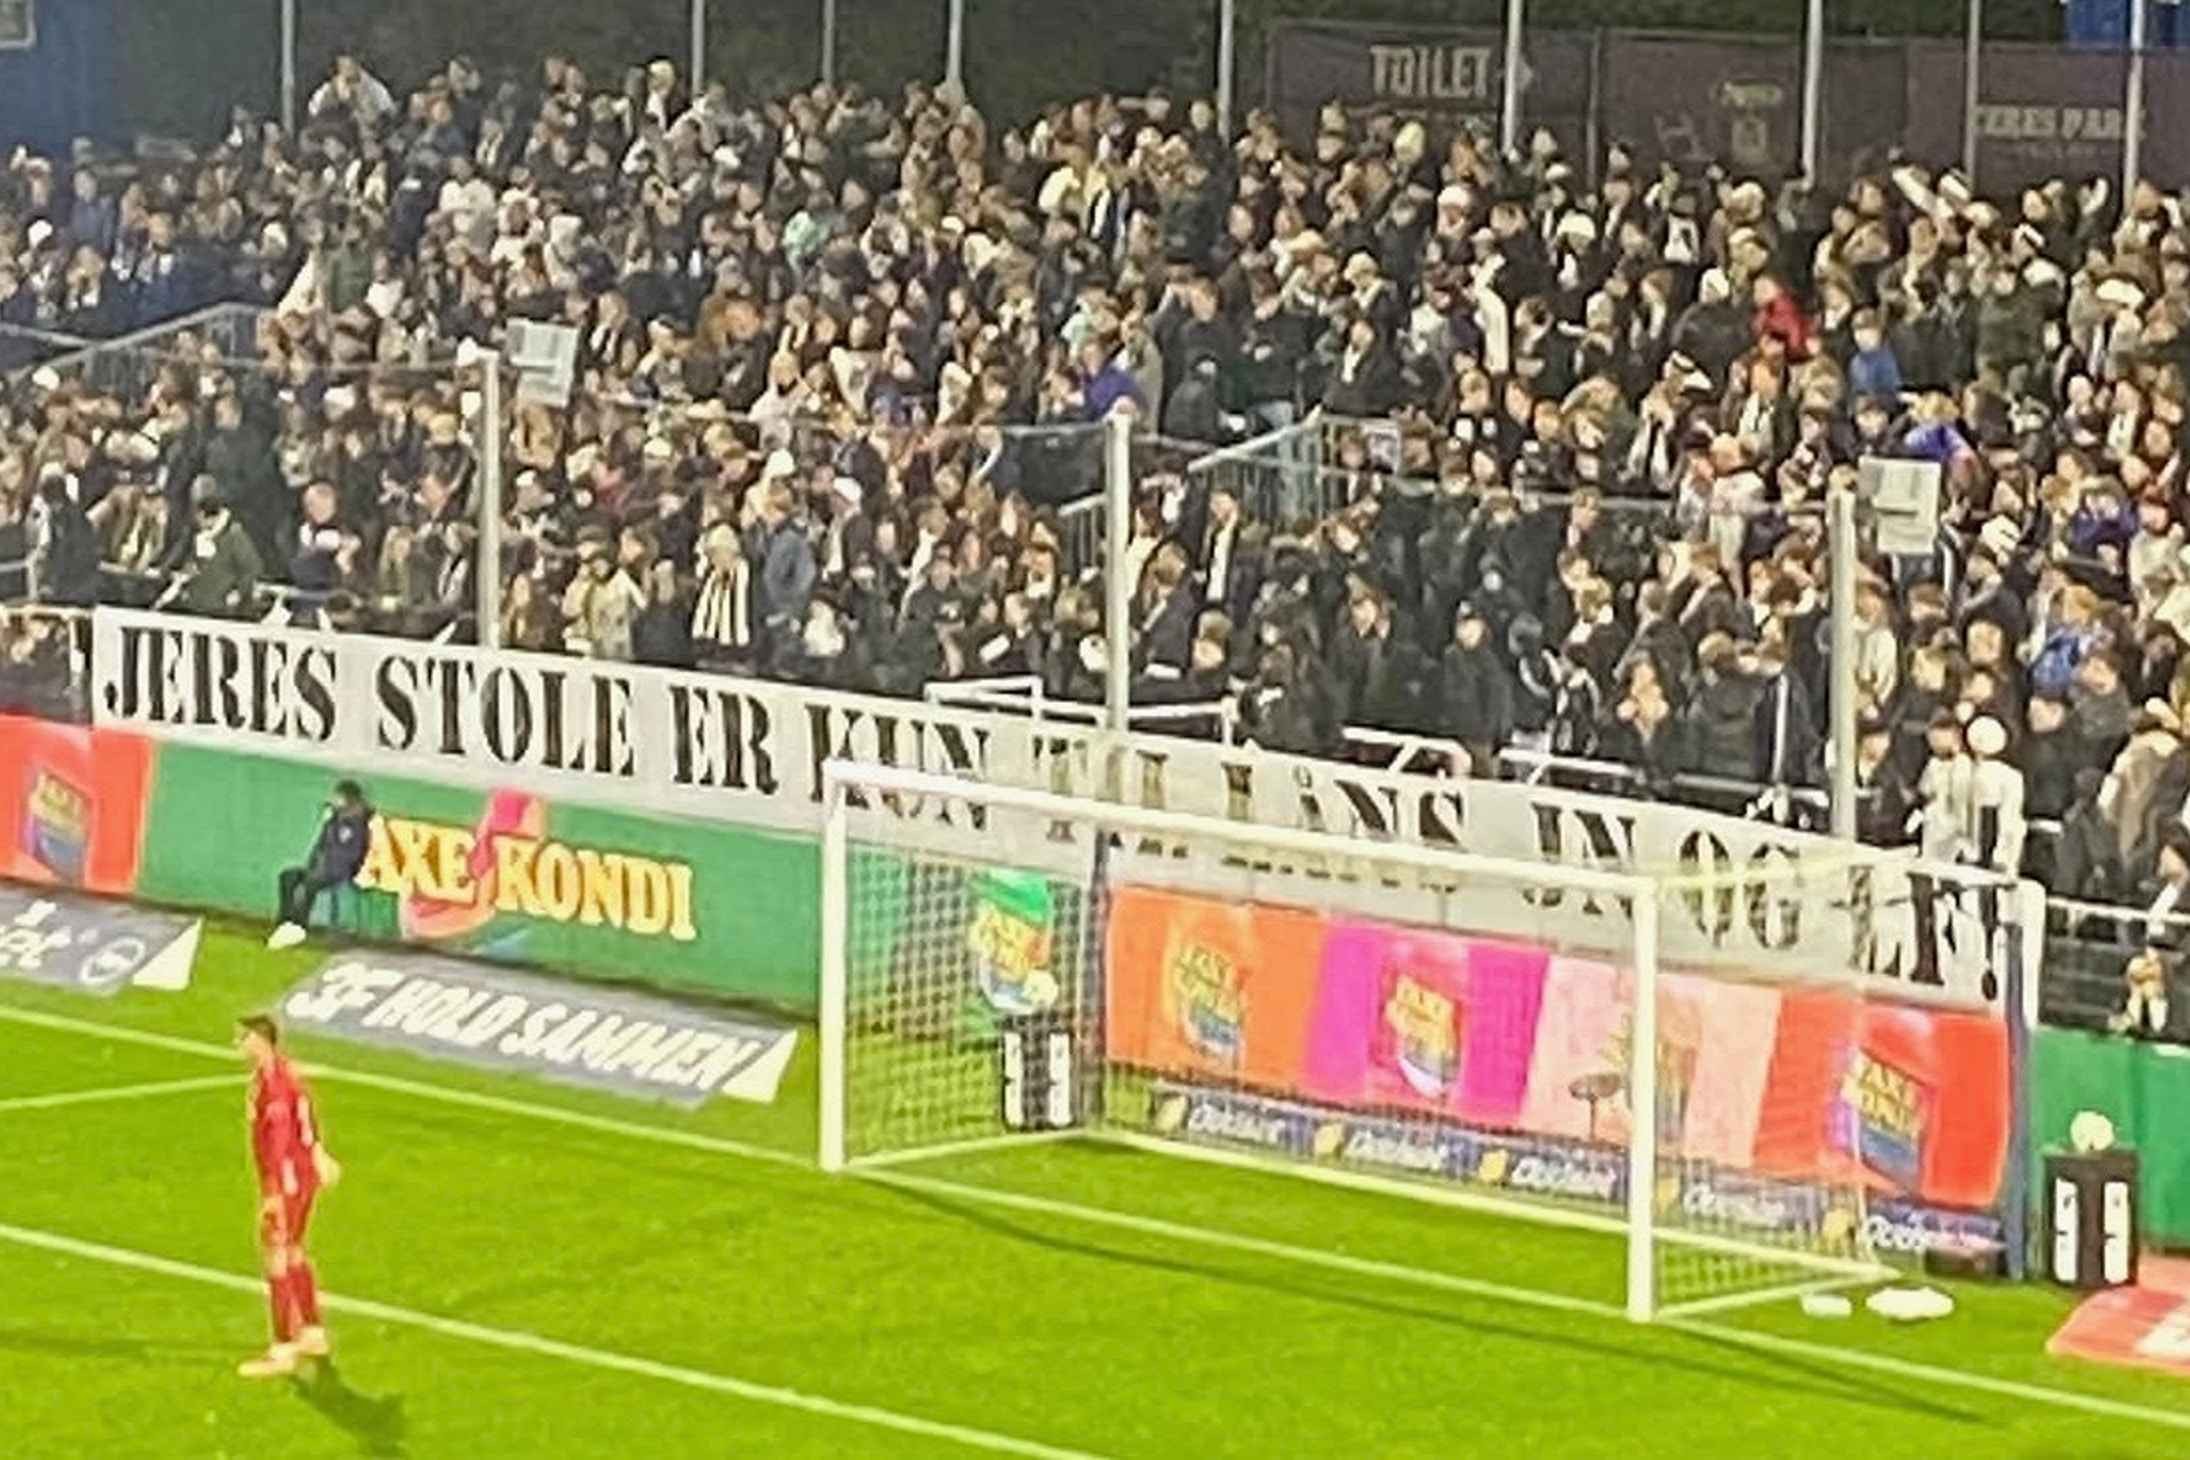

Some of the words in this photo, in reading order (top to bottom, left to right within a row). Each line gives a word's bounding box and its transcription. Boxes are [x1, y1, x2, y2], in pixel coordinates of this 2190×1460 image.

[1370, 44, 1491, 98] TOILET
[104, 626, 338, 742] JERES
[376, 653, 636, 777] STOLE
[669, 684, 779, 795] ER
[804, 703, 990, 831] KUN
[353, 814, 477, 904] AXE
[491, 834, 698, 941] KONDI
[285, 960, 404, 1022] 3F
[361, 973, 530, 1048] HOLD
[499, 1003, 762, 1091] SAMMEN
